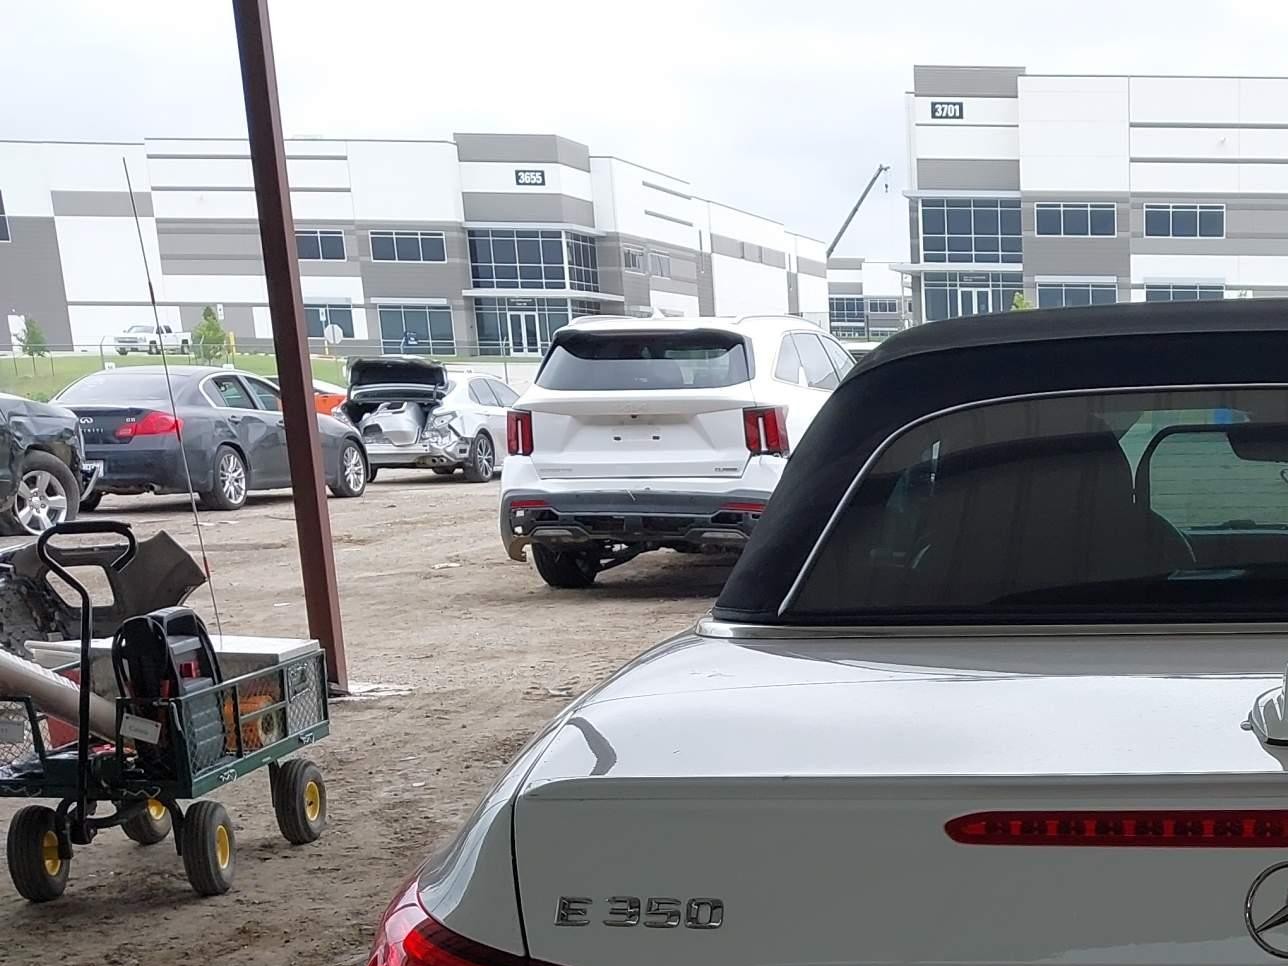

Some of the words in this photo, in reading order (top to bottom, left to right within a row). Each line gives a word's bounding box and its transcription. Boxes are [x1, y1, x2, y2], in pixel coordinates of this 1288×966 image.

[935, 103, 960, 117] 3701
[518, 171, 543, 184] 3655
[554, 896, 593, 926] E
[603, 896, 724, 929] 350
